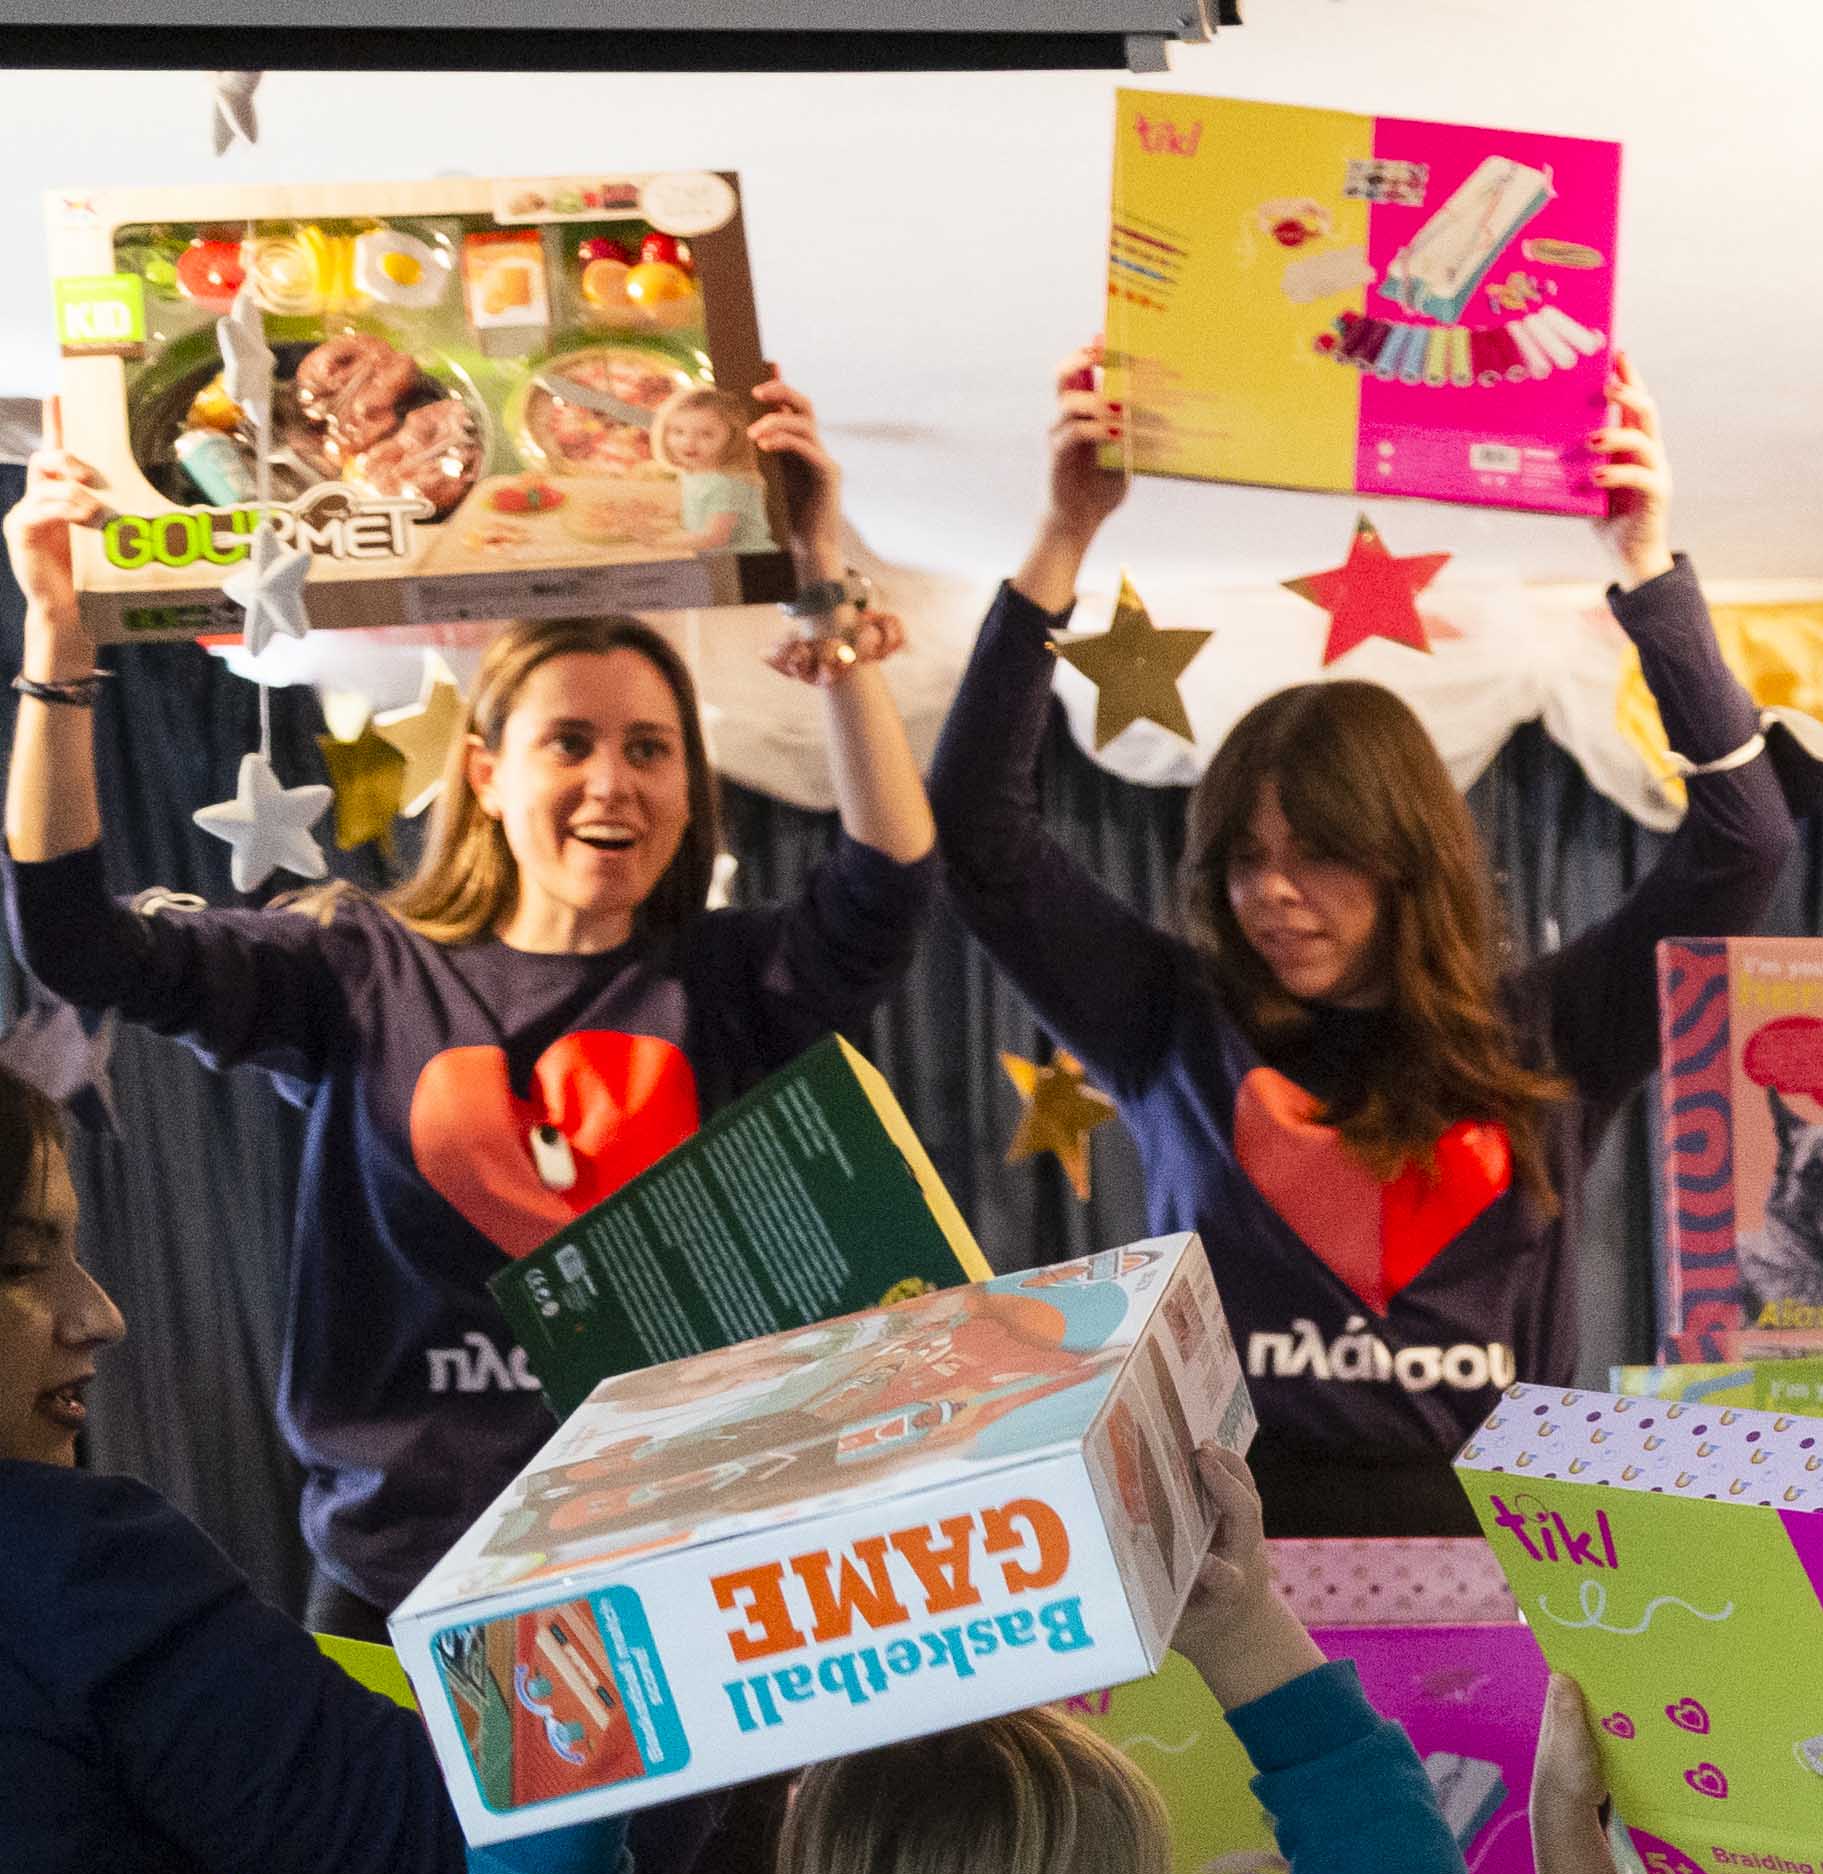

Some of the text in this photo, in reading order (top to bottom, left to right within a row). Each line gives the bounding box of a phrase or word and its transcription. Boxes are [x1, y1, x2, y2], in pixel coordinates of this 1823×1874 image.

[63, 301, 133, 338] KID
[708, 1497, 1073, 1663] GAME
[1489, 1494, 1619, 1569] tikl
[721, 1596, 1094, 1734] Basketball
